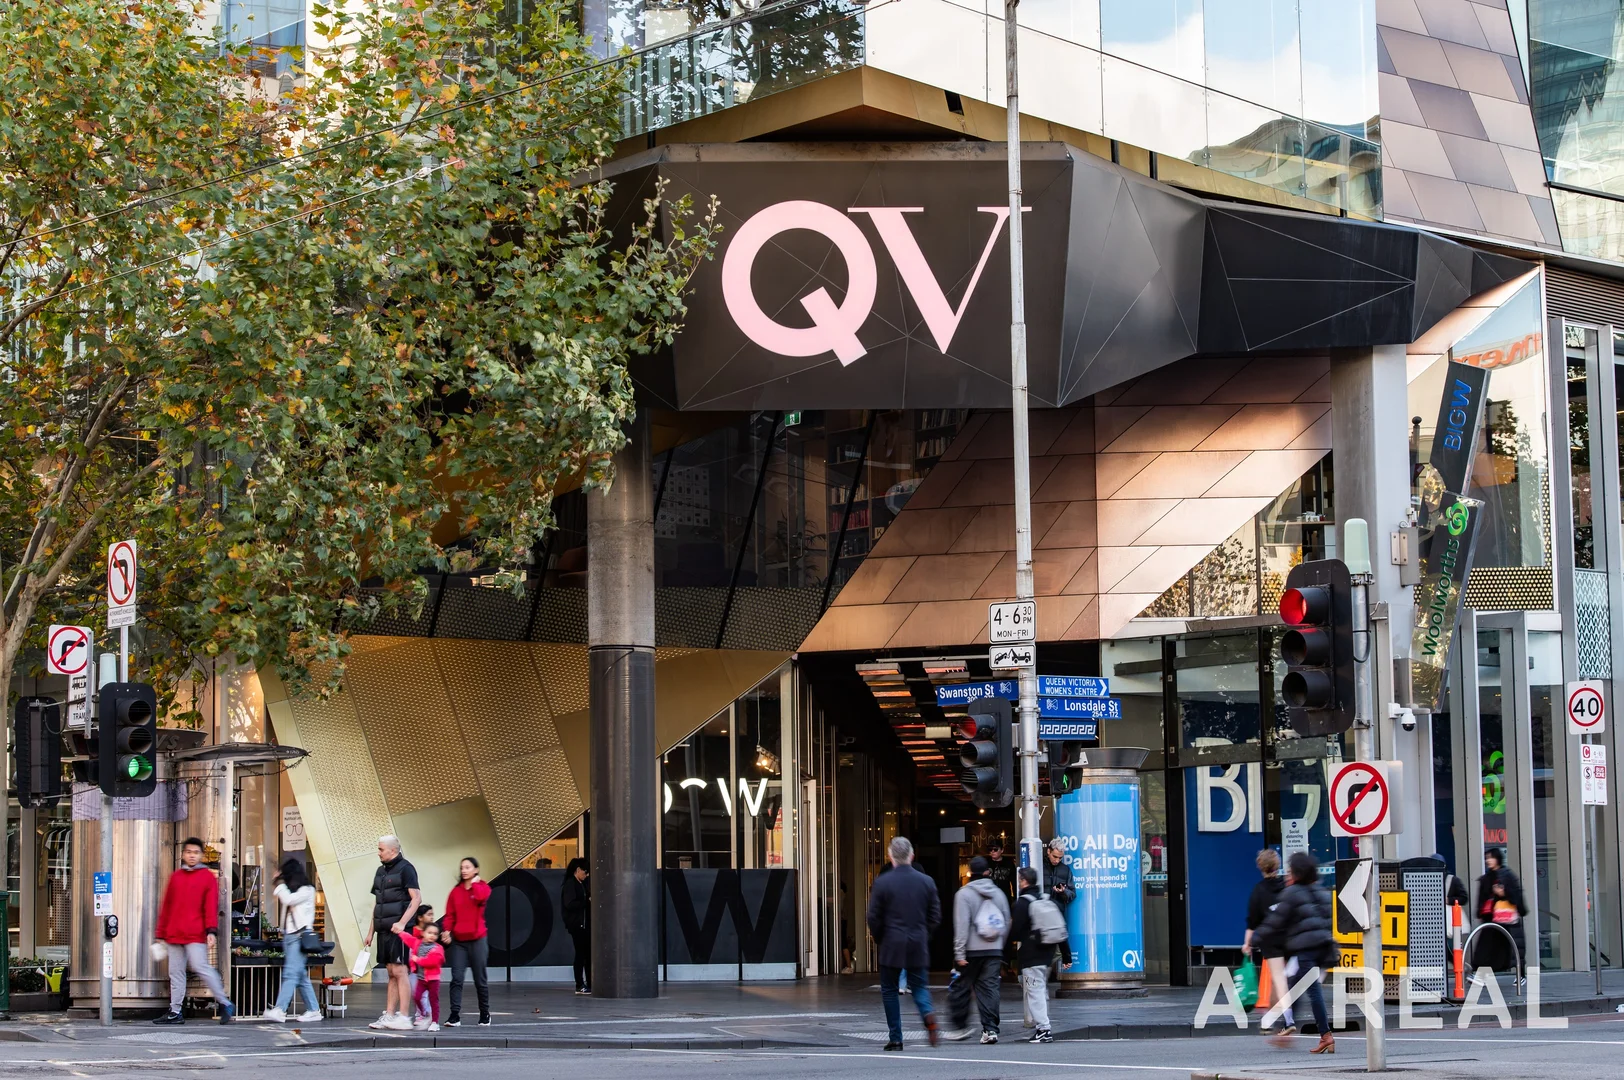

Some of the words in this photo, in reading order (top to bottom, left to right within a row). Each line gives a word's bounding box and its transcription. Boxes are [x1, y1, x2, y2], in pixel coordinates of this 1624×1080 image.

[721, 199, 1033, 368] QV
[1421, 538, 1460, 657] Woolworths
[1022, 606, 1032, 616] 30
[996, 629, 1029, 638] MON-FRI
[1045, 677, 1066, 686] QUEEN
[1068, 678, 1097, 687] VICTORIA
[939, 686, 983, 699] Swanston
[984, 684, 994, 696] St
[1045, 686, 1072, 695] WOMEN'S
[1074, 687, 1098, 696] CENTRE
[1064, 699, 1106, 711] Lonsdale
[1108, 700, 1118, 711] St
[1572, 697, 1599, 717] 40
[1083, 834, 1107, 850] All
[1113, 834, 1138, 853] Day
[1100, 875, 1120, 883] spend
[1122, 949, 1143, 969] QV
